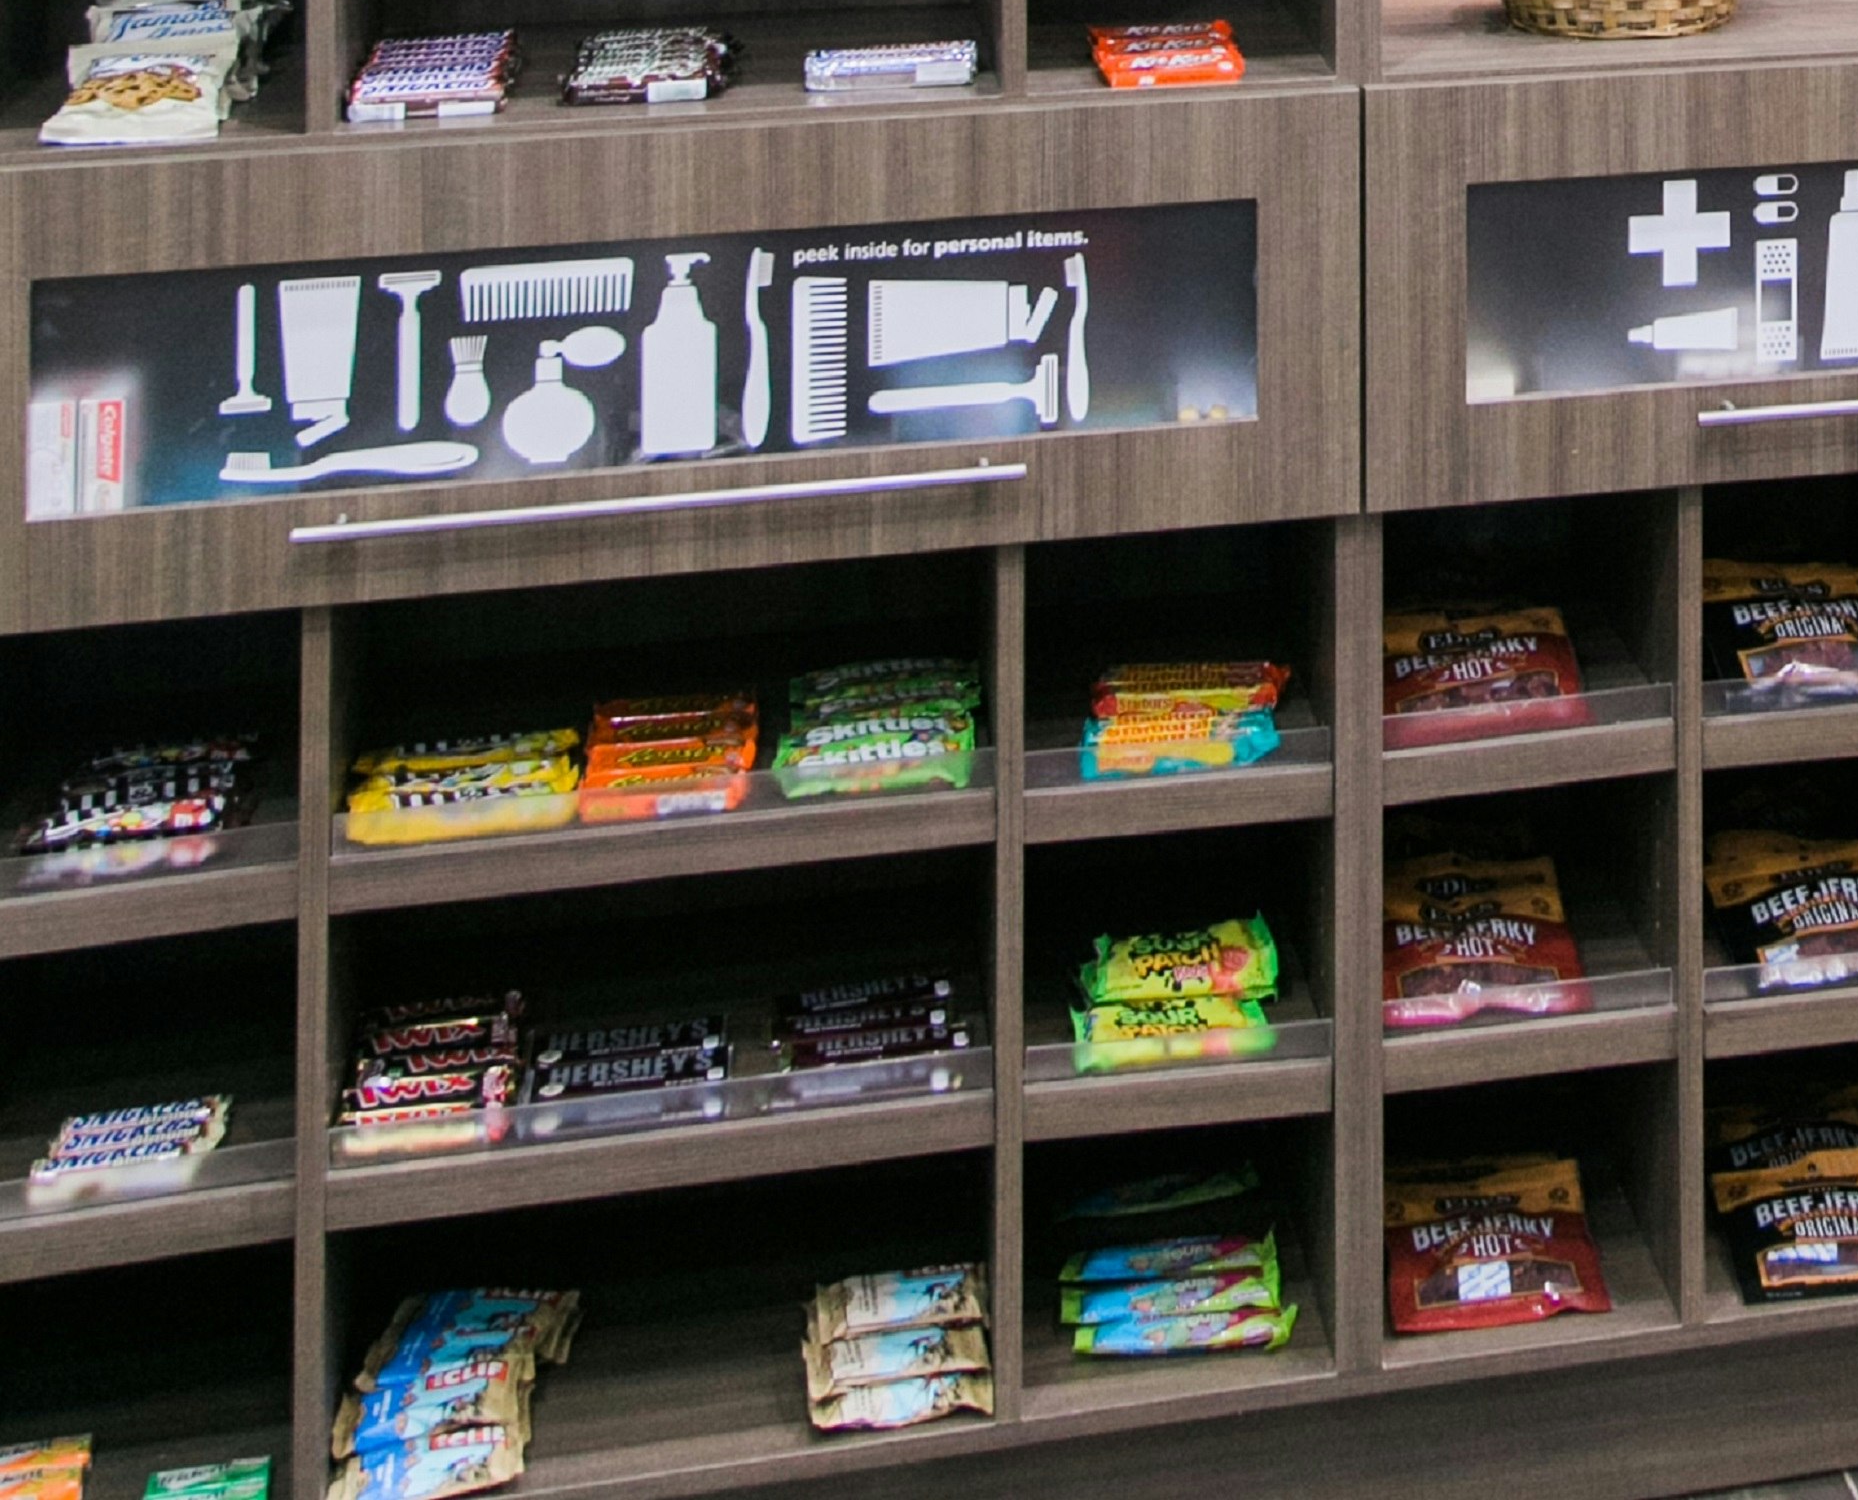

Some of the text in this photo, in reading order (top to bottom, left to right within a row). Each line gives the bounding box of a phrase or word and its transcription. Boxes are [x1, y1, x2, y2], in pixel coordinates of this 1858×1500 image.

[793, 230, 1089, 268] peek inside for personal items.
[1452, 659, 1494, 681] HOT
[1750, 887, 1810, 925] BEEF
[1456, 936, 1494, 957] HOT
[549, 1047, 713, 1088] HERSHEY'S
[1755, 1194, 1814, 1227] BEEF
[1411, 1221, 1473, 1252] BEEF
[1472, 1234, 1513, 1258] HOT
